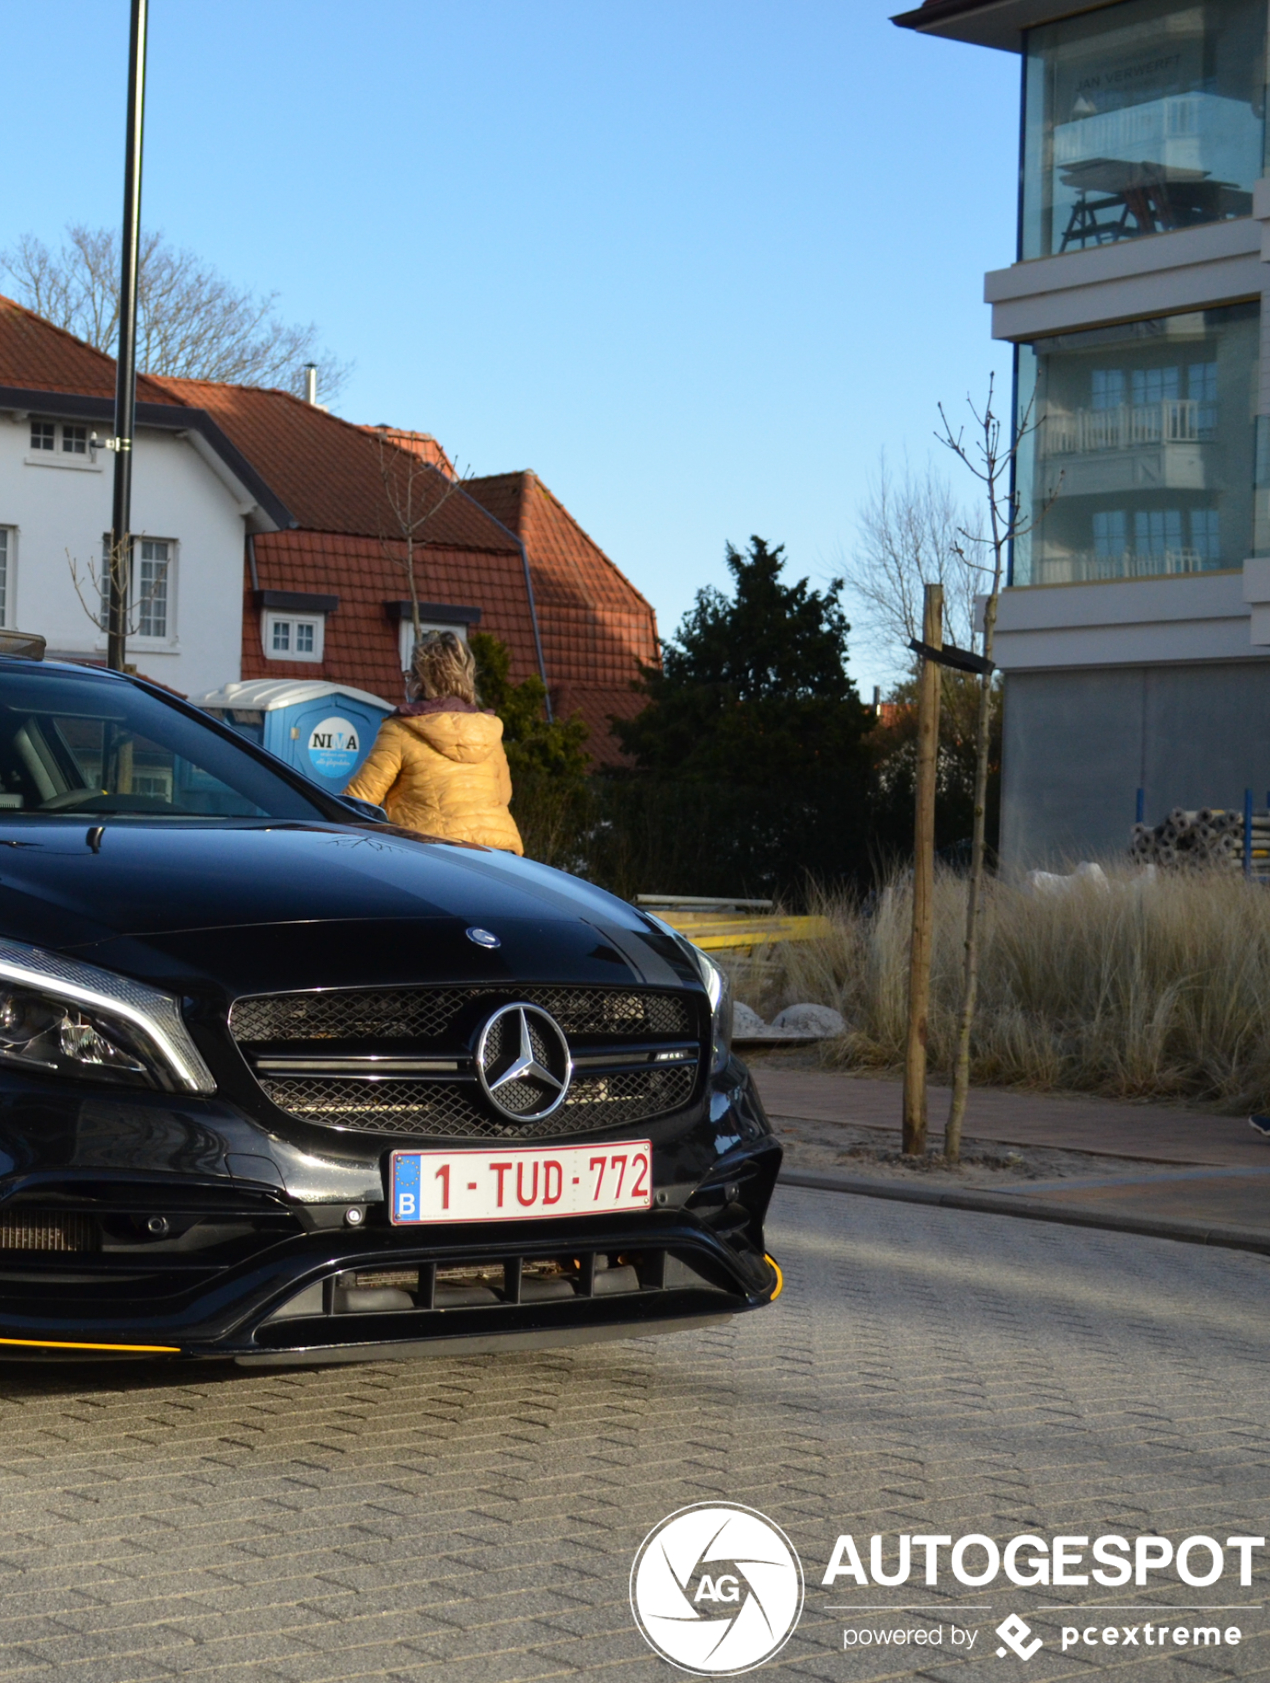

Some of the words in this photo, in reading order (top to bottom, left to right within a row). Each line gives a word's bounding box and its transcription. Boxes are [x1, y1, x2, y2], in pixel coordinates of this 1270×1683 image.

[1076, 75, 1101, 92] JAN
[312, 731, 357, 750] NIMA
[399, 1193, 415, 1215] B
[435, 1153, 648, 1210] 1-TUD-772
